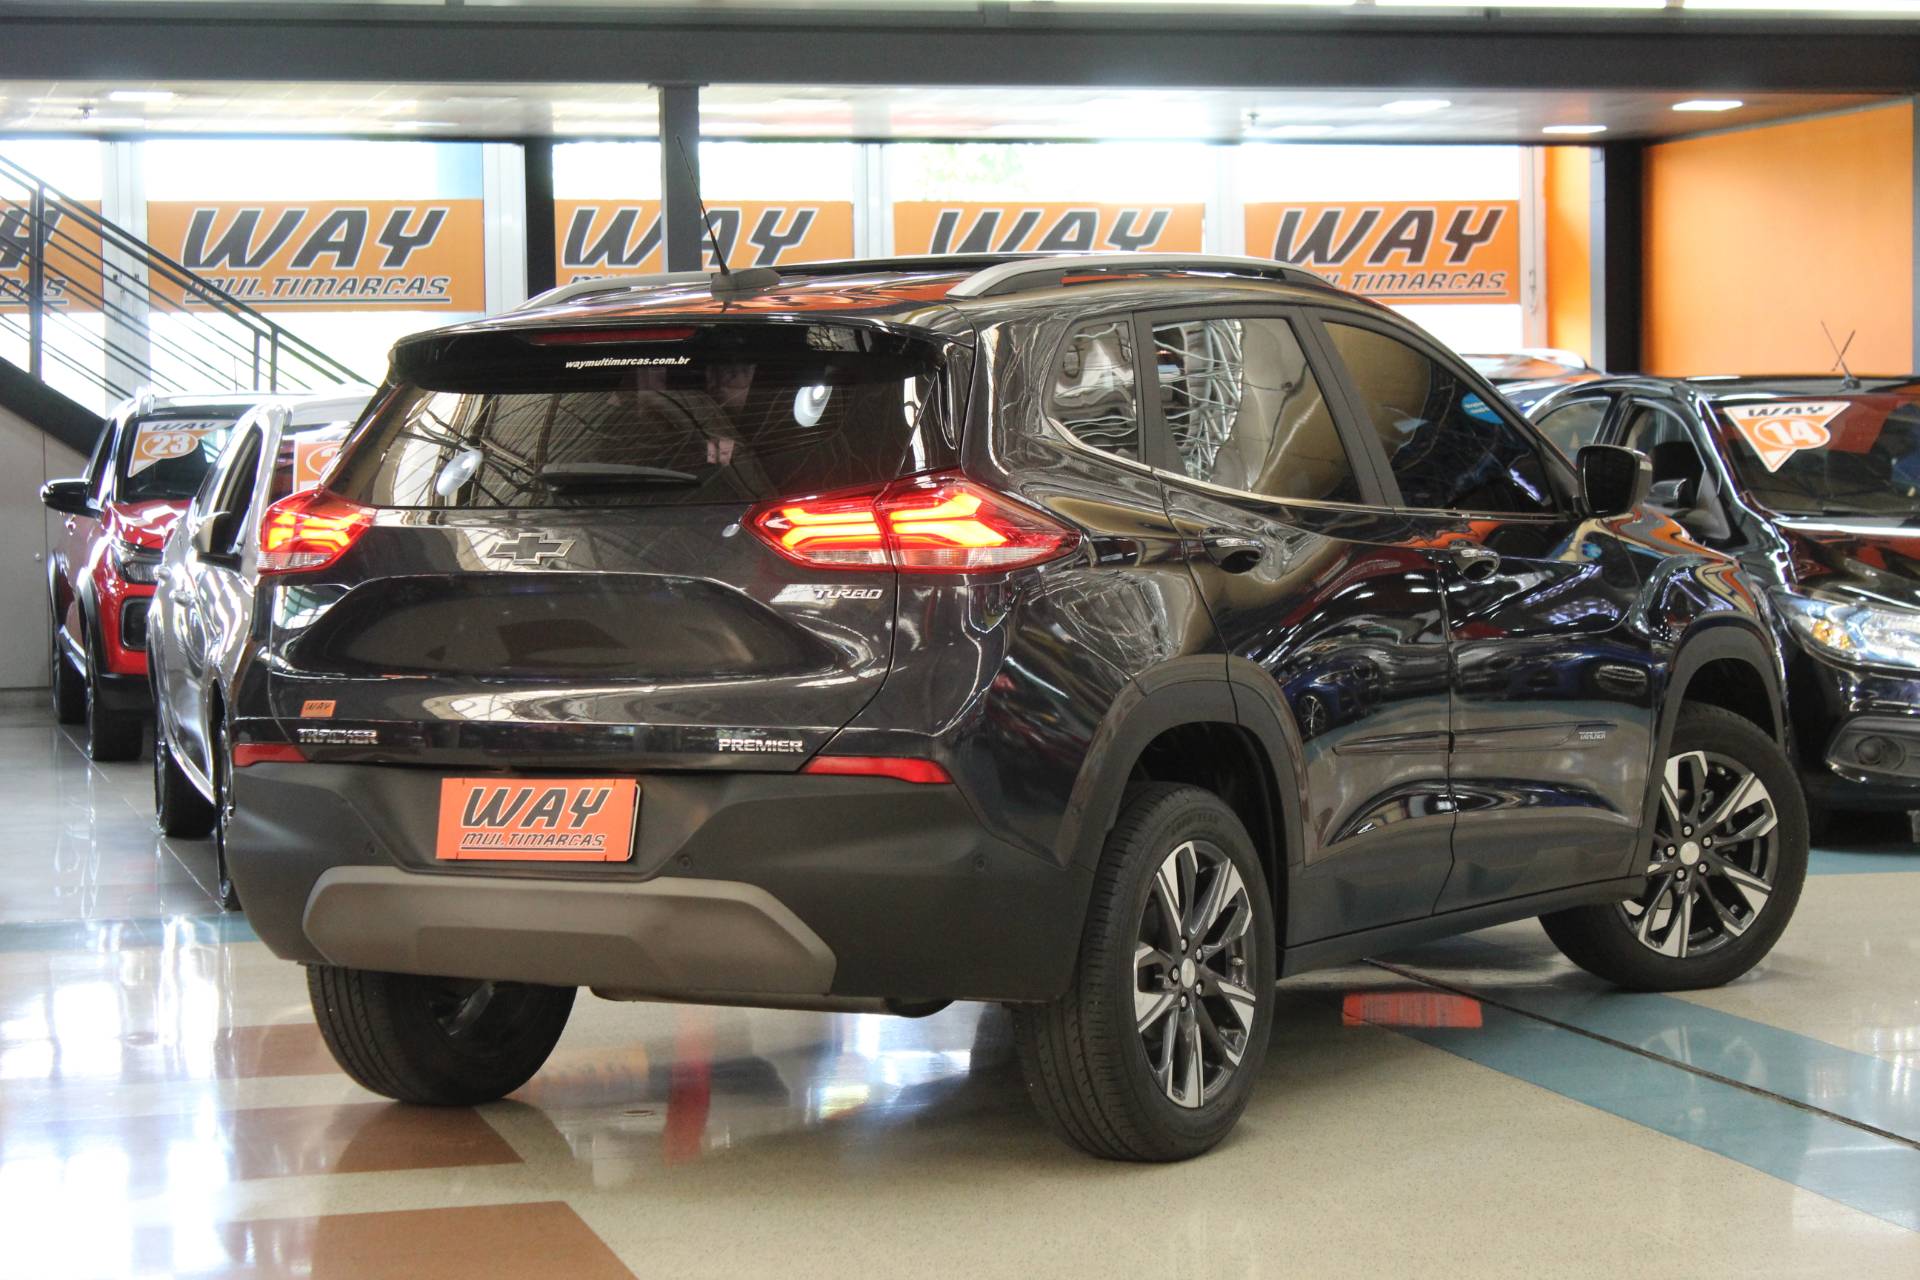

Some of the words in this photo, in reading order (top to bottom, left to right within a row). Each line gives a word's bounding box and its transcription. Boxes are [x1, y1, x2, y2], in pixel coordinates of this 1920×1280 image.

[182, 207, 451, 271] WAY
[561, 207, 819, 268] WAY
[929, 208, 1173, 254] WAY
[1273, 207, 1508, 268] WAY
[565, 356, 691, 370] waymultimarcas.com.br
[151, 431, 190, 455] 23
[1763, 420, 1821, 445] 14
[813, 588, 883, 600] TURBO
[718, 738, 804, 752] PREMIER
[461, 786, 613, 829] WAY
[461, 832, 607, 848] MULTIMARCAS
